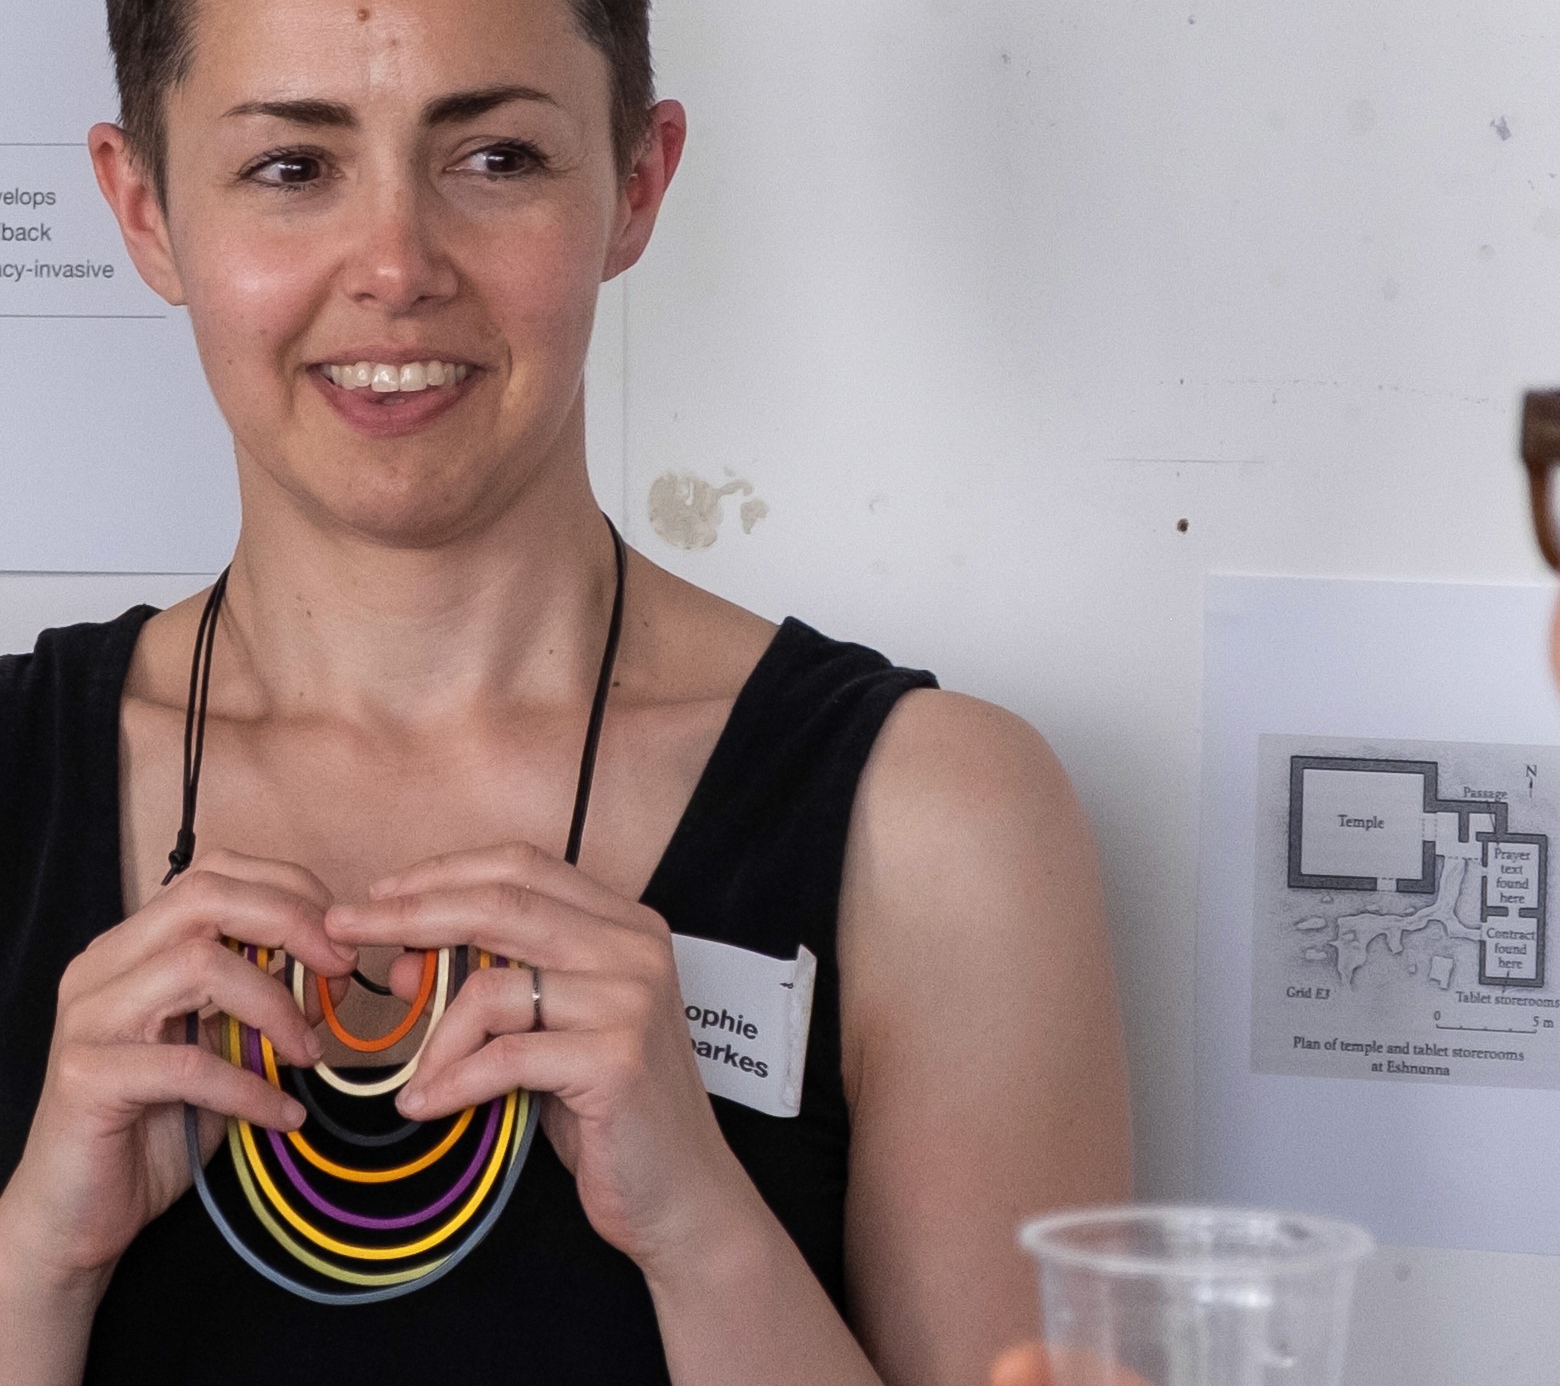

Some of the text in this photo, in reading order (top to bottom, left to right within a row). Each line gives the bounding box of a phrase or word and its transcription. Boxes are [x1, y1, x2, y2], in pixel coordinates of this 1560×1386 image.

[1337, 814, 1385, 832] Temple
[685, 1004, 759, 1040] ophie
[691, 1038, 769, 1079] arkes
[1292, 1035, 1524, 1061] Plan of temple and tablet storerooms
[1371, 1059, 1451, 1076] at Eshnunna
